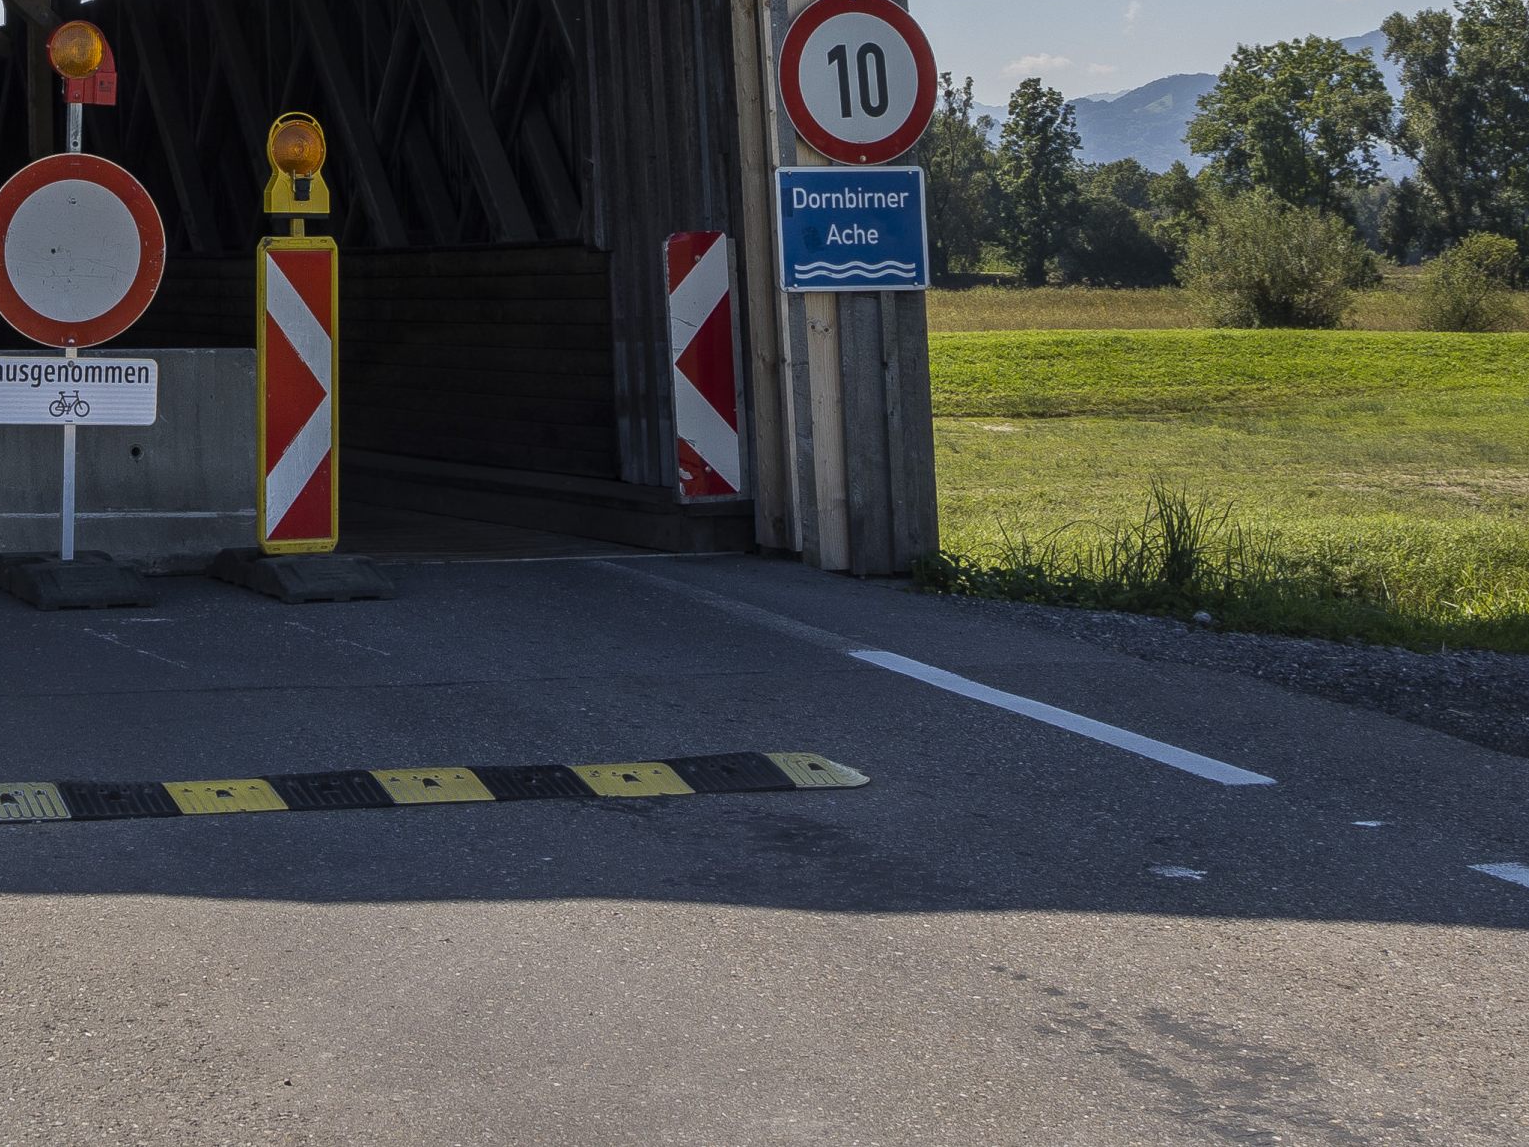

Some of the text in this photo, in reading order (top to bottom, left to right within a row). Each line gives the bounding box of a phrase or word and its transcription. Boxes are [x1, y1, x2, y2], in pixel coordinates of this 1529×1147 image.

[826, 41, 890, 120] 10
[792, 187, 909, 209] Dornbirner
[826, 223, 879, 245] Ache
